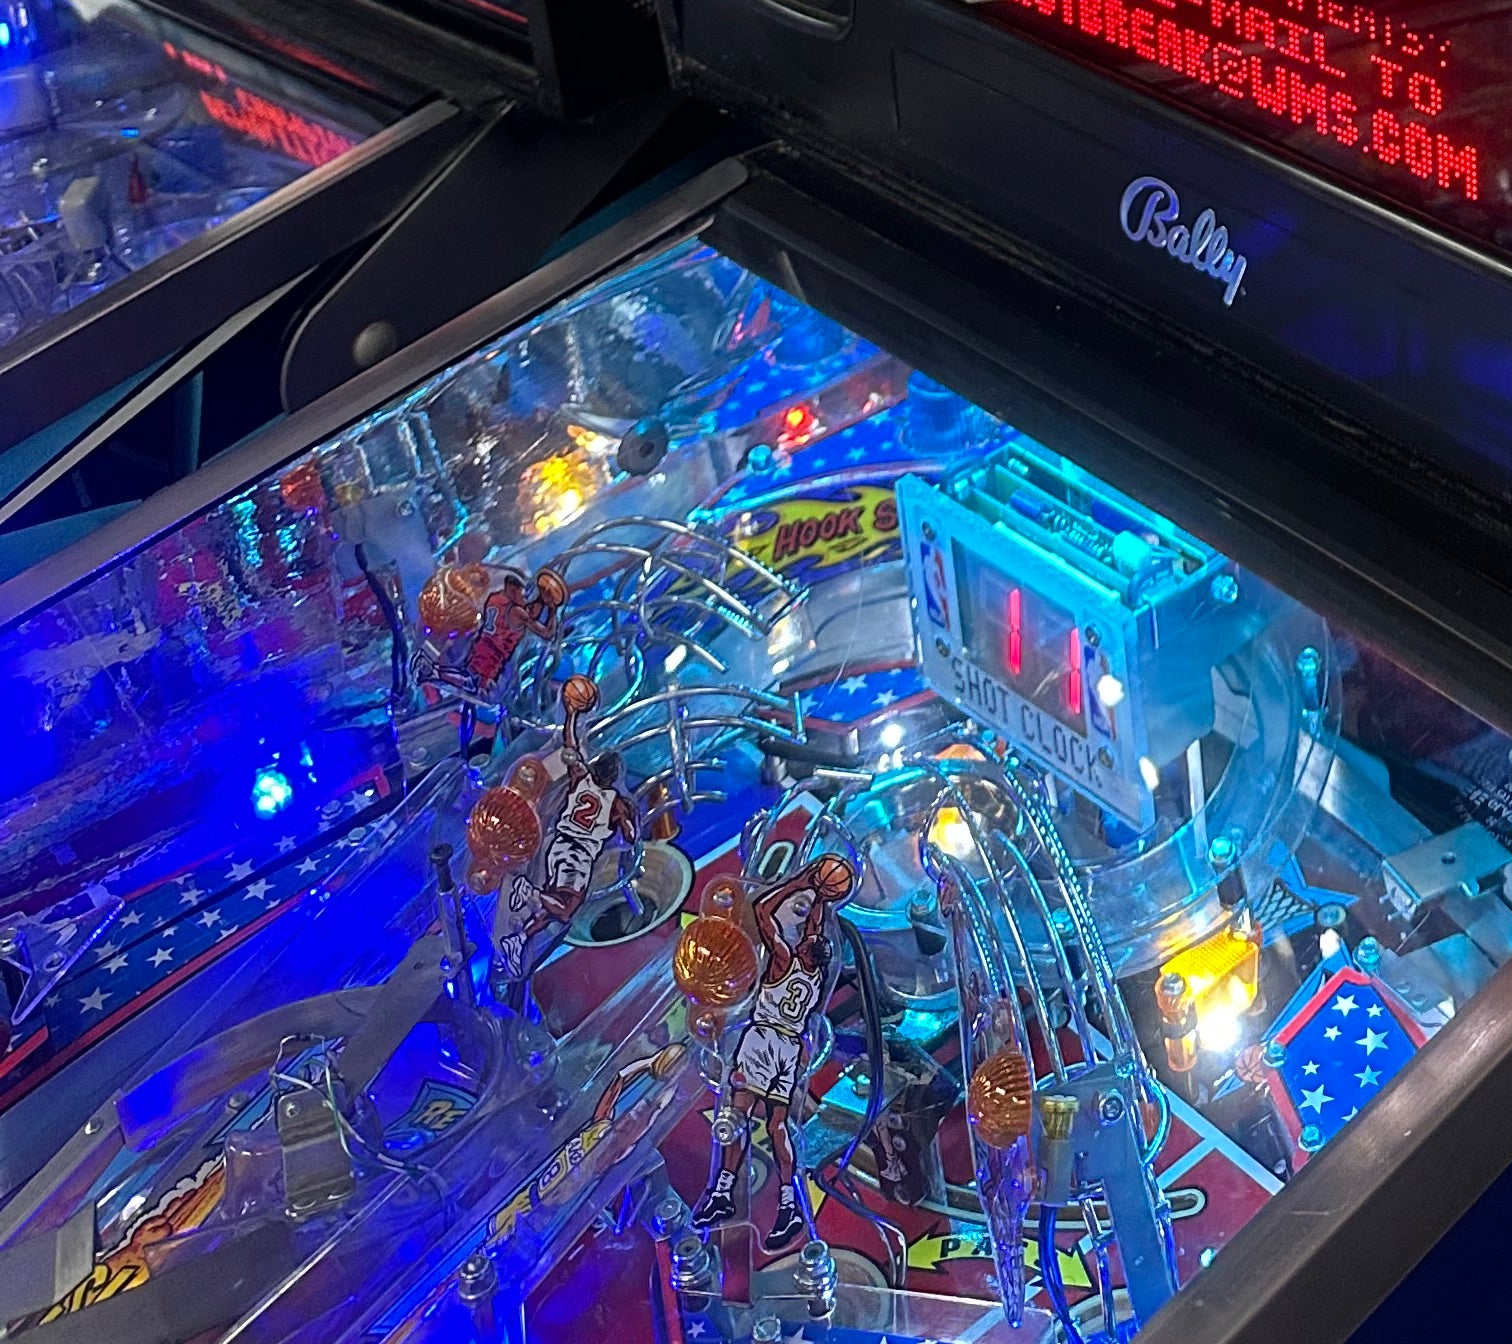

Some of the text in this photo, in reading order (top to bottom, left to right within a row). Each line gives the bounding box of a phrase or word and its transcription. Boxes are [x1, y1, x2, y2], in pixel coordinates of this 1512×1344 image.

[1369, 53, 1442, 117] TO
[1120, 176, 1247, 306] Bally
[773, 506, 865, 563] HOOK
[951, 655, 1103, 789] SHOT CLOCK
[570, 789, 602, 833] 2
[778, 977, 813, 1023] 3
